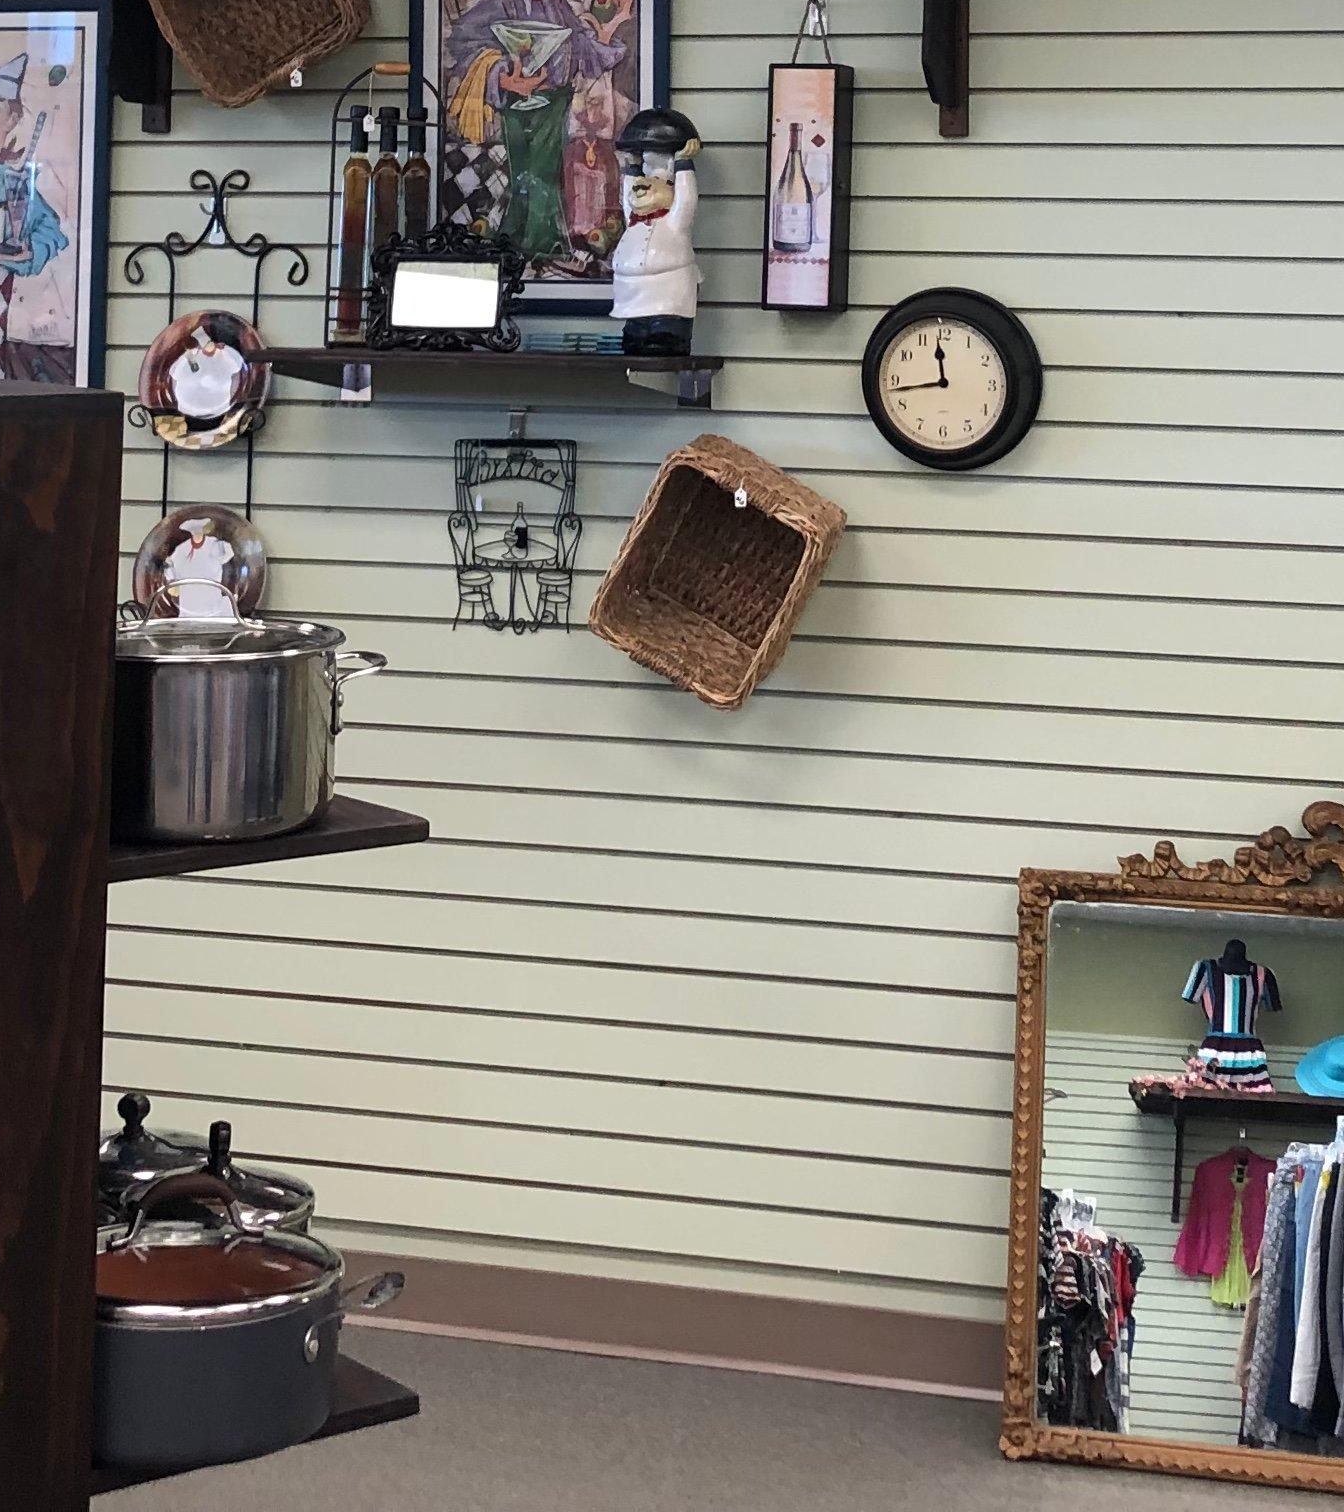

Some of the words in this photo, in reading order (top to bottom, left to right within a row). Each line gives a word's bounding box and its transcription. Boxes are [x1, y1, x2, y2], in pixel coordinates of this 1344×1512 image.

[918, 333, 928, 347] 11
[937, 328, 952, 342] 12
[965, 336, 972, 349] 1
[900, 349, 913, 362] 10
[980, 354, 990, 367] 2
[890, 374, 900, 386] 9
[987, 379, 998, 392] 3
[897, 398, 908, 411] 8
[915, 418, 925, 431] 7
[962, 419, 973, 433] 5
[938, 425, 948, 438] 6
[467, 449, 560, 485] Bistro
